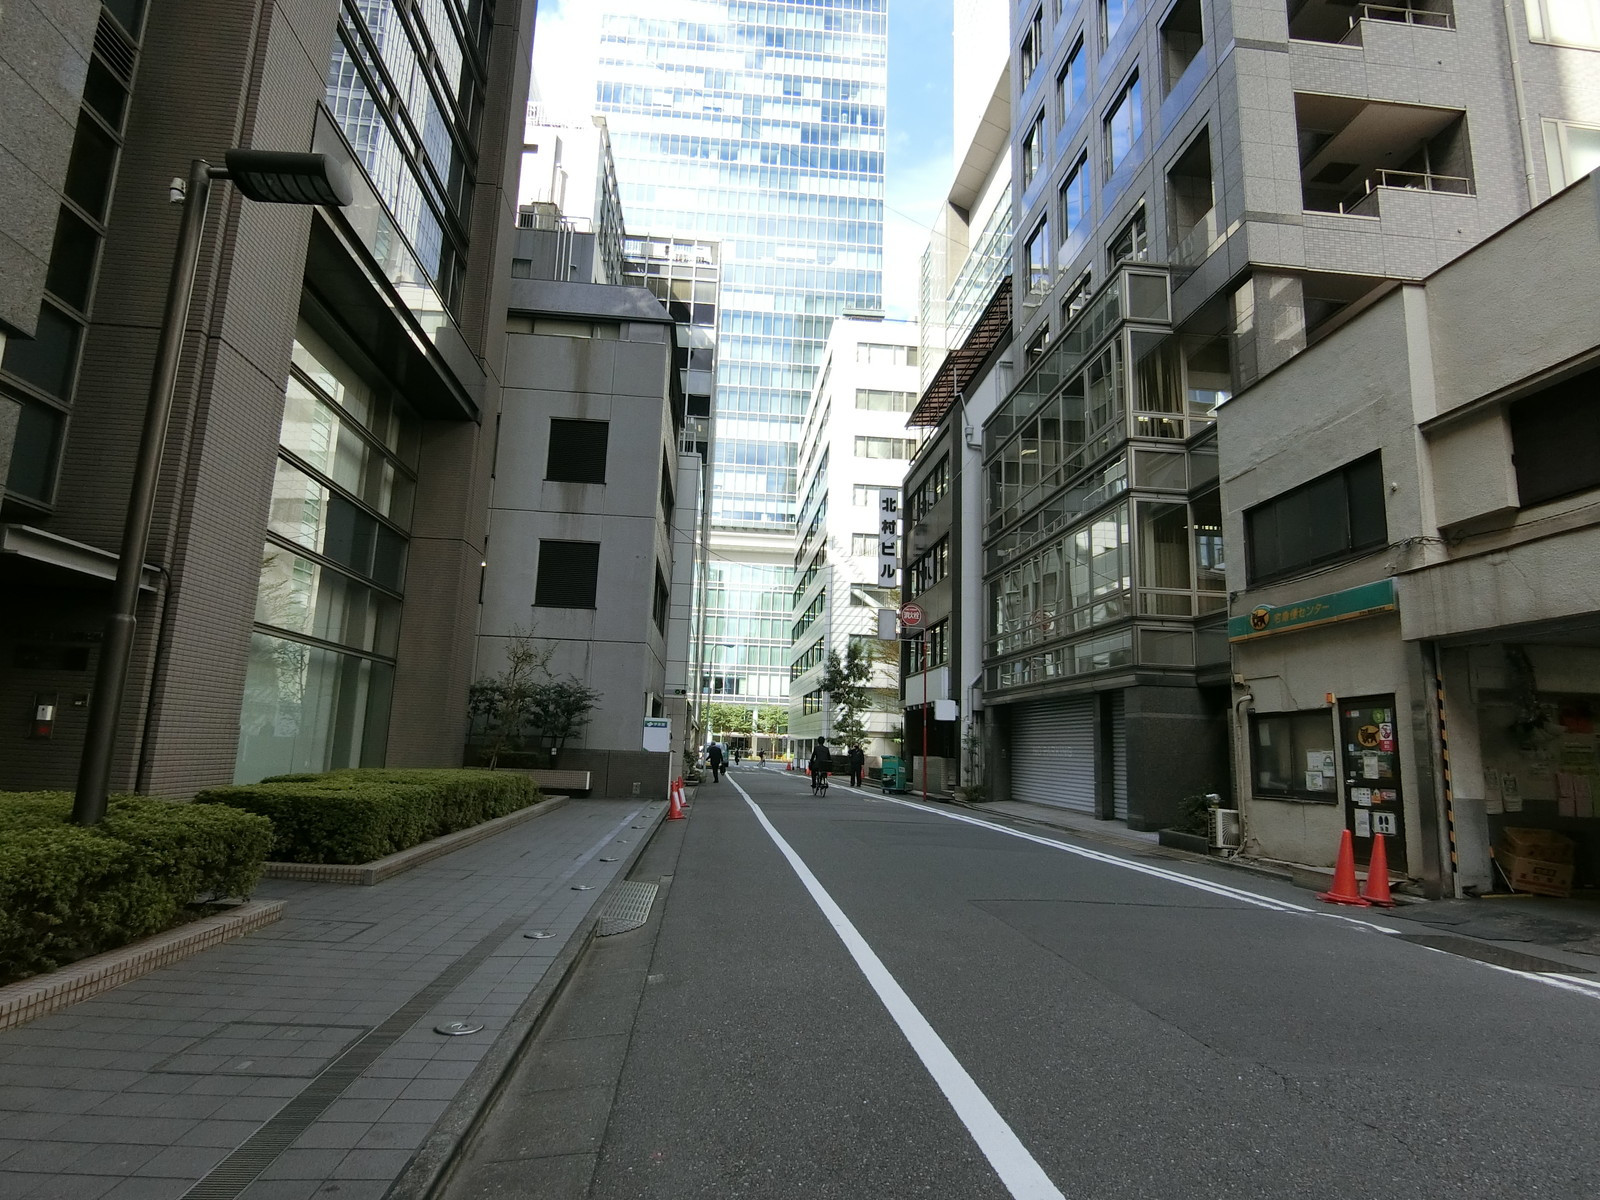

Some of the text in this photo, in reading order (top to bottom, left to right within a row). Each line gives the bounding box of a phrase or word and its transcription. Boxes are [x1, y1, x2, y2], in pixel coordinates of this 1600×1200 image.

[881, 497, 897, 579] 北村ビル
[903, 611, 920, 620] 消火栓
